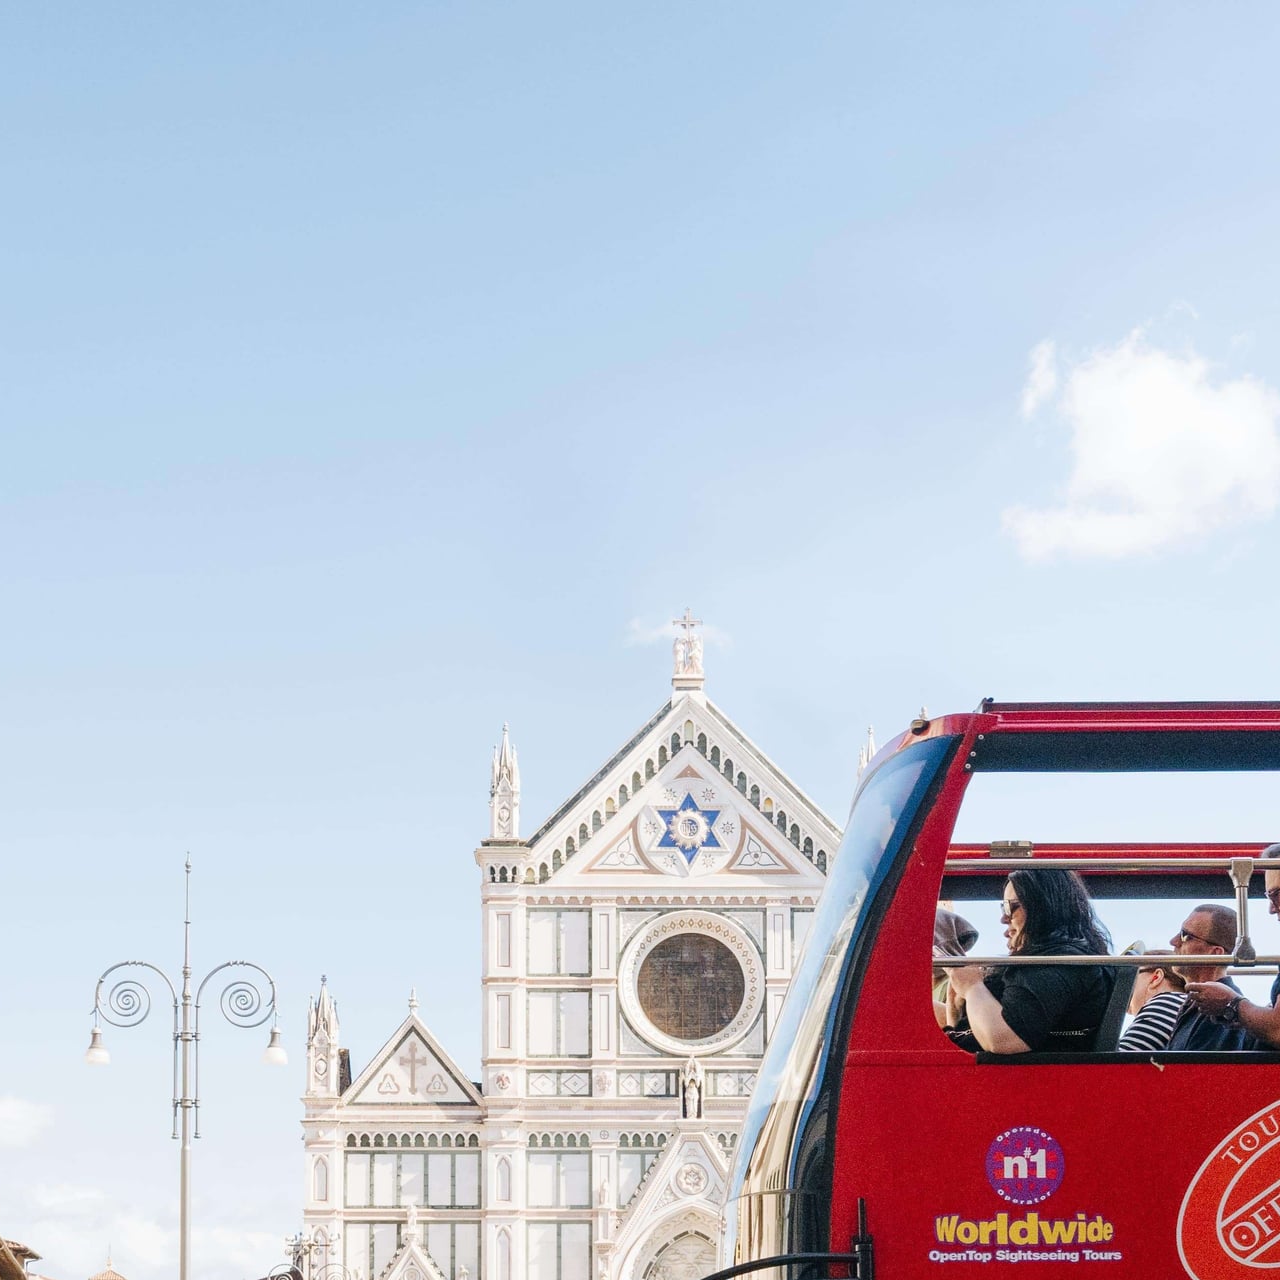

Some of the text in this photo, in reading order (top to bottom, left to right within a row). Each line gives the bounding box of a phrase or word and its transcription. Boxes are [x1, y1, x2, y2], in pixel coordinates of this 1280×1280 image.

[996, 1127, 1053, 1142] Operador
[996, 1188, 1052, 1205] Operator
[935, 1212, 1113, 1245] Worldwide
[929, 1250, 1122, 1262] OpenTop Sightseeing Tours
